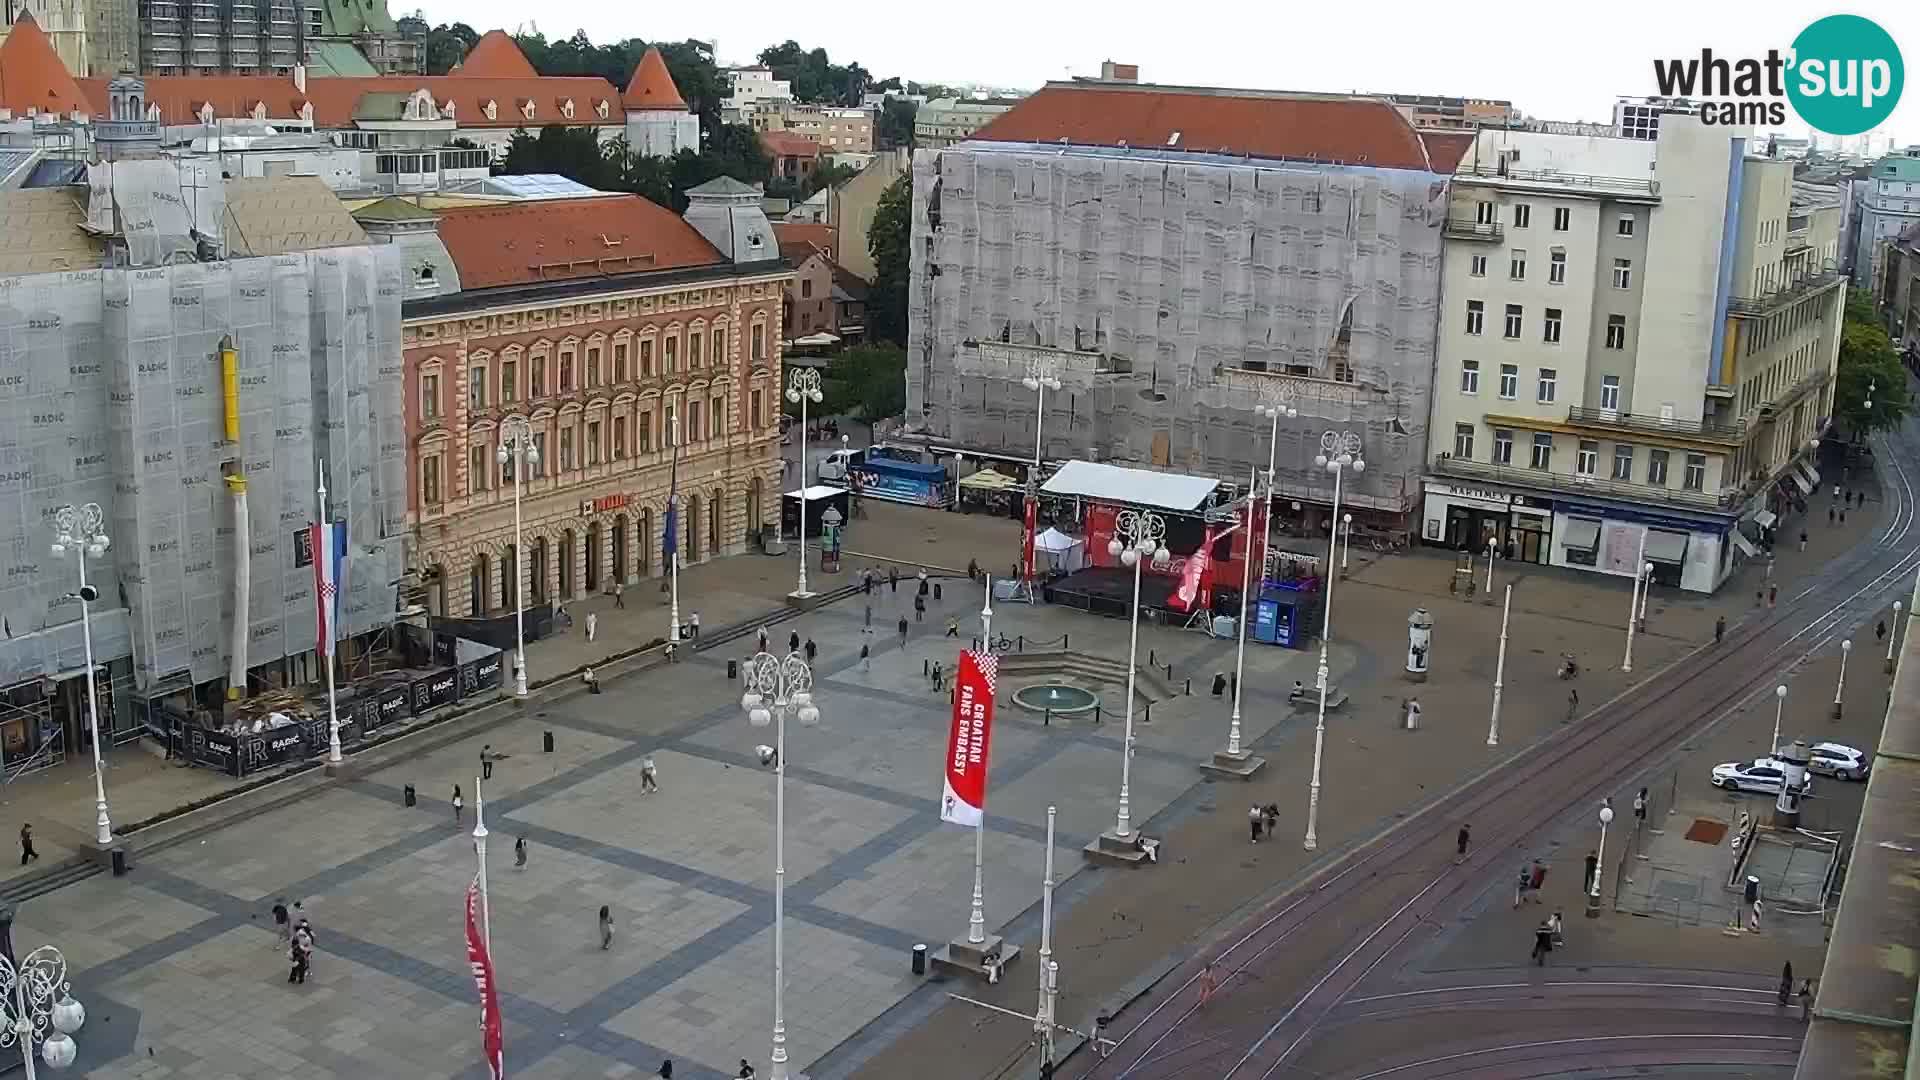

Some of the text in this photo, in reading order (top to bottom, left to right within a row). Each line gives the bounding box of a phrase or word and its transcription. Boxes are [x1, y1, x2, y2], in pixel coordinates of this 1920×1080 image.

[953, 685, 974, 776] FANS EMBASSY
[969, 703, 985, 763] CROATIAN
